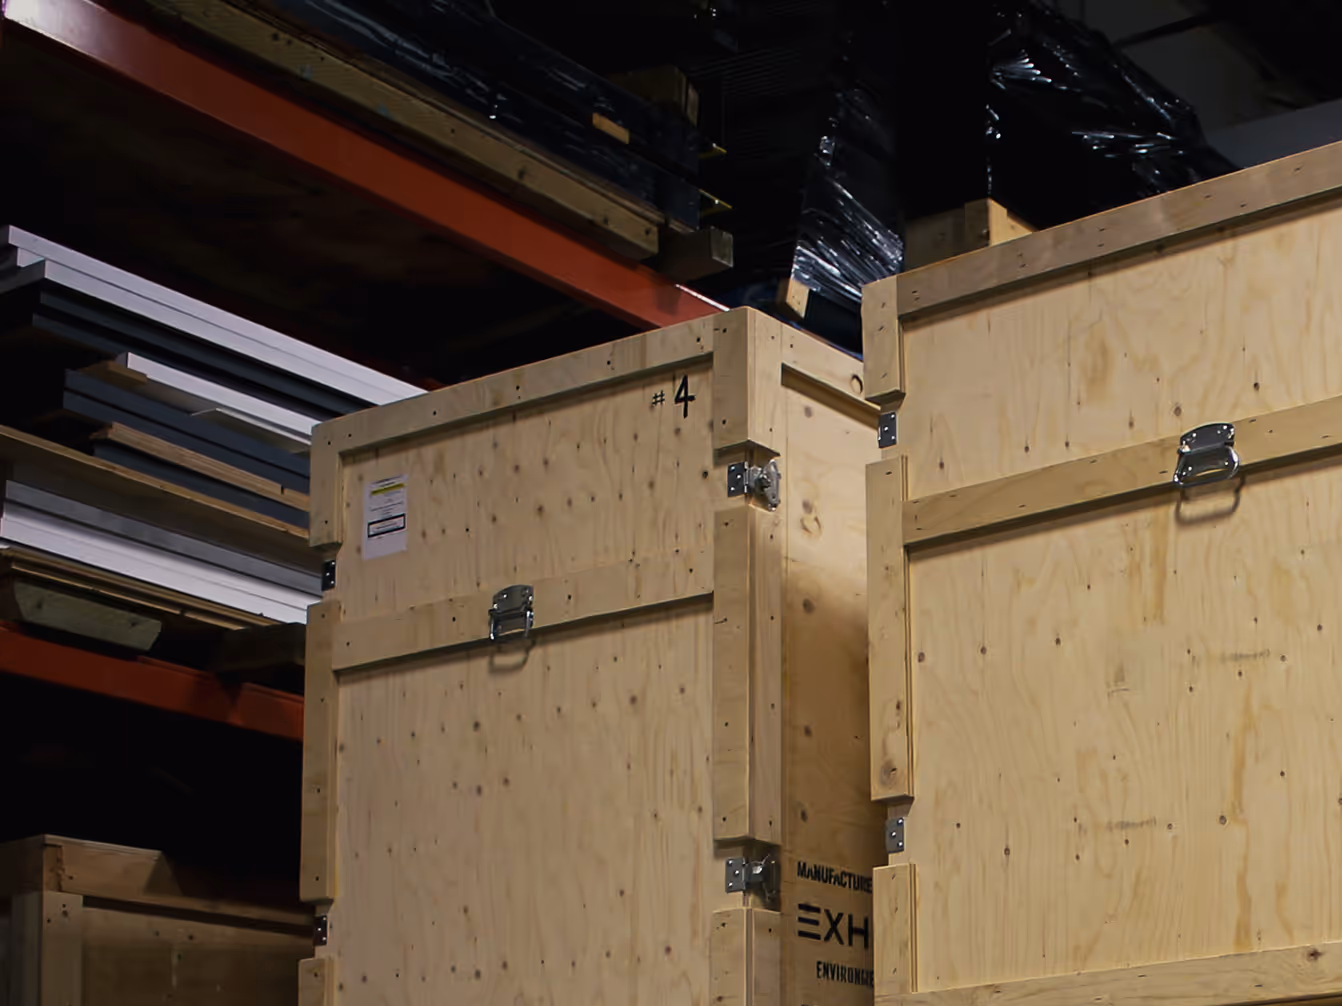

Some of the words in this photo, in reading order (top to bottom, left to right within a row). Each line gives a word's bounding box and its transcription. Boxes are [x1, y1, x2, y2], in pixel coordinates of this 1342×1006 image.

[651, 374, 696, 419] #4
[797, 860, 873, 894] MANUFACTURE
[797, 903, 870, 950] EXH
